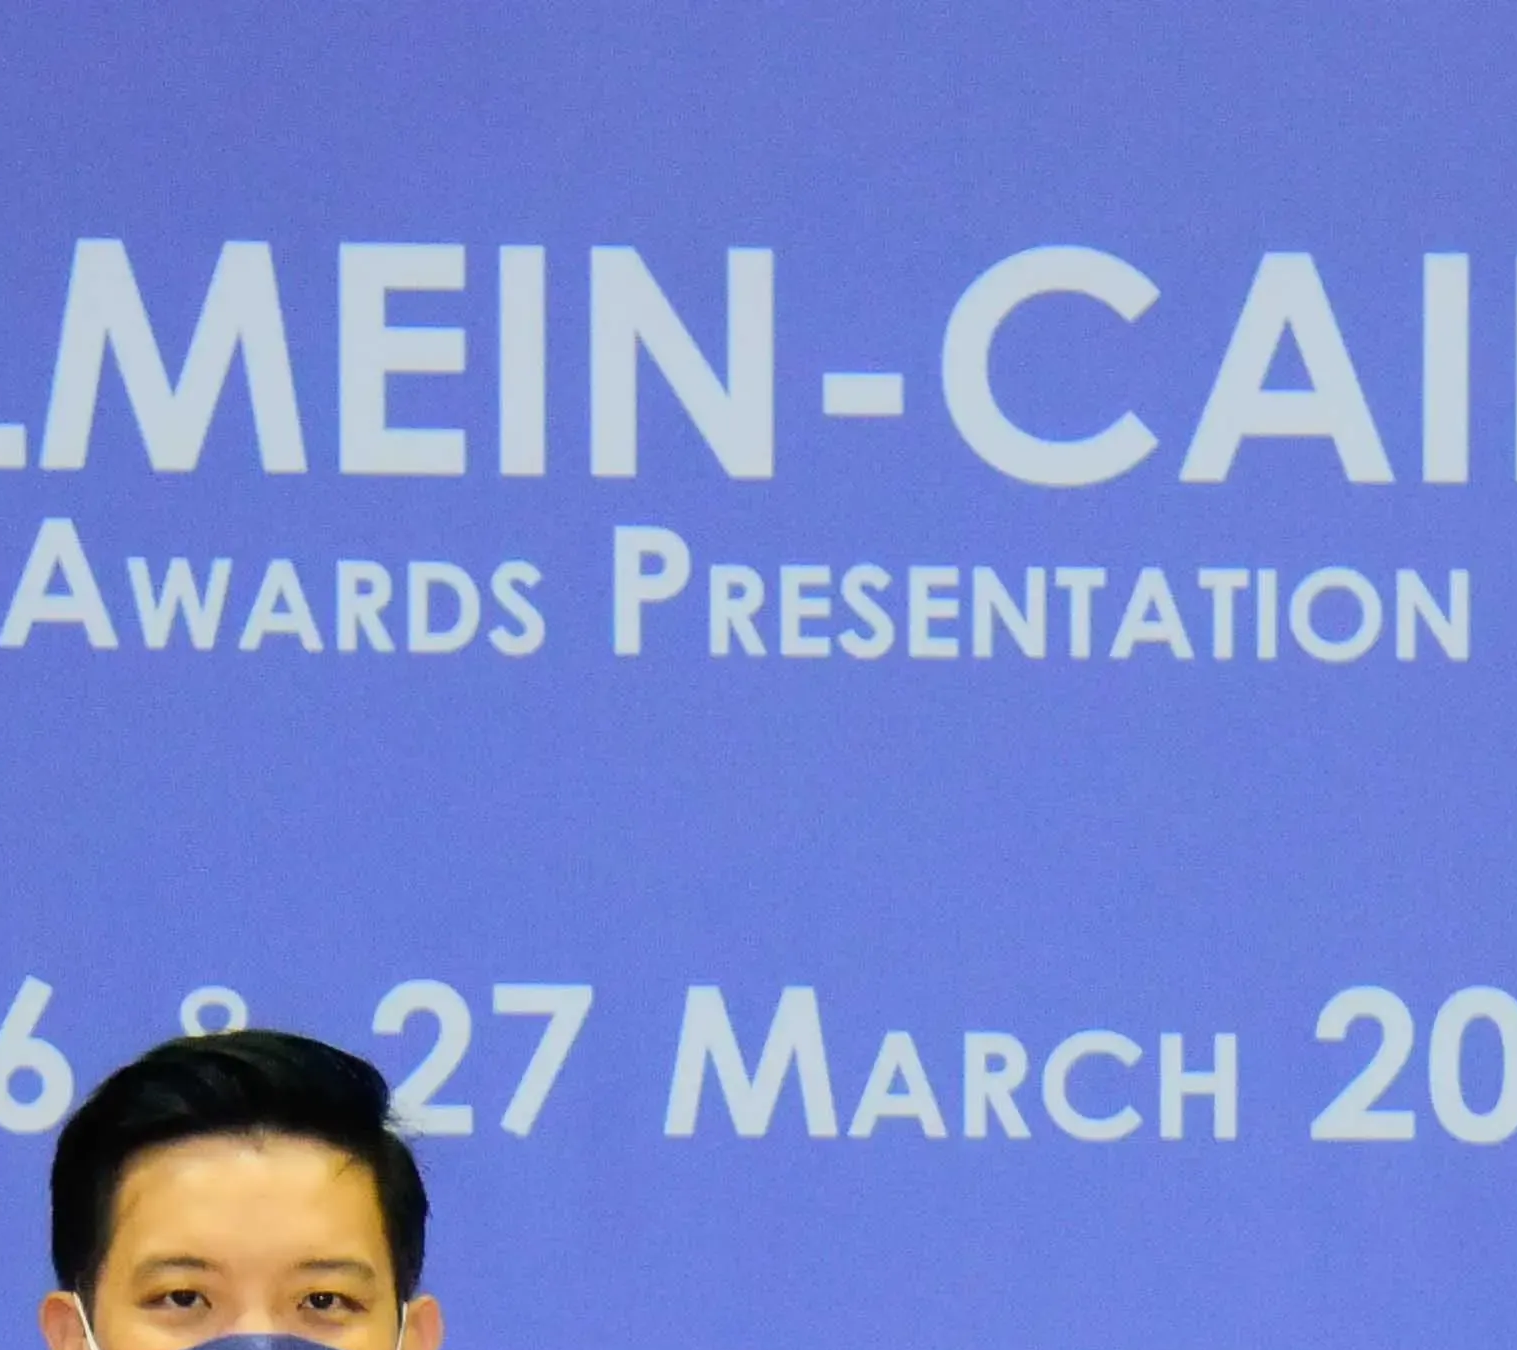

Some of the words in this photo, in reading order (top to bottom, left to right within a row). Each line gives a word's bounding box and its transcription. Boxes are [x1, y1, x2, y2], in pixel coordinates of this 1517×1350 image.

[613, 526, 1470, 663] PRESENTATION
[371, 979, 594, 1137] 27
[663, 985, 1238, 1142] MARCH
